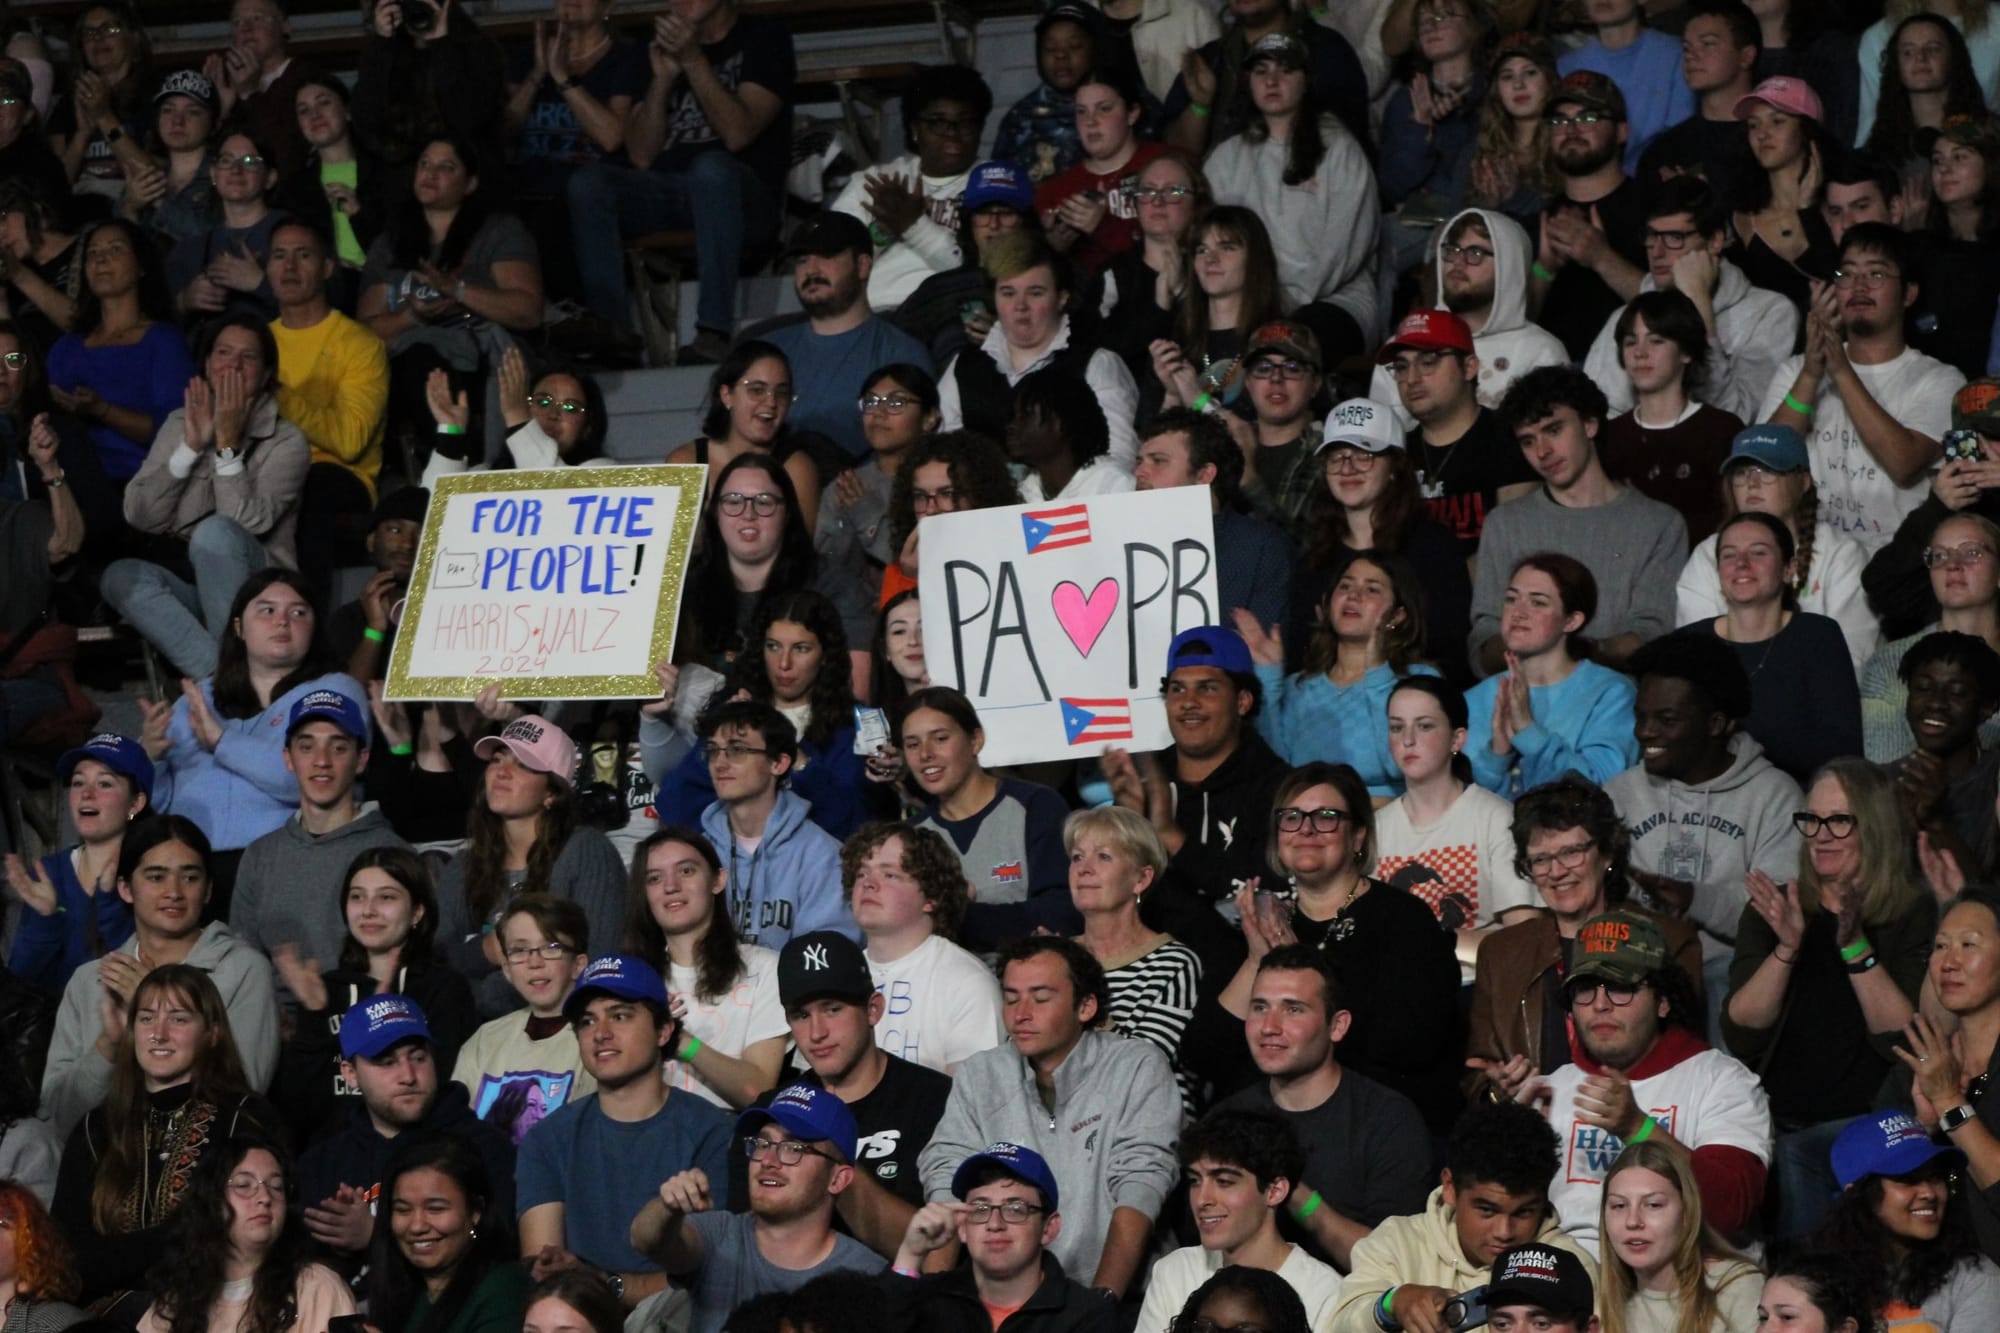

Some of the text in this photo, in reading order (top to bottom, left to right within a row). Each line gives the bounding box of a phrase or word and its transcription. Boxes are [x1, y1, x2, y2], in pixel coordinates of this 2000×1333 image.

[1333, 405, 1374, 421] HARRIS
[1338, 416, 1365, 427] WALZ
[471, 494, 655, 537] FOR THE
[480, 543, 646, 595] PEOPLE!
[432, 603, 621, 655] HARRIS WALZ
[944, 559, 1053, 702] PA
[474, 655, 548, 675] 2024
[1630, 811, 1677, 840] NAVAL
[1581, 921, 1630, 942] HARRIS
[802, 942, 830, 971] NY
[1507, 1258, 1555, 1270] HARRIS
[1508, 1249, 1559, 1264] KAMALA
